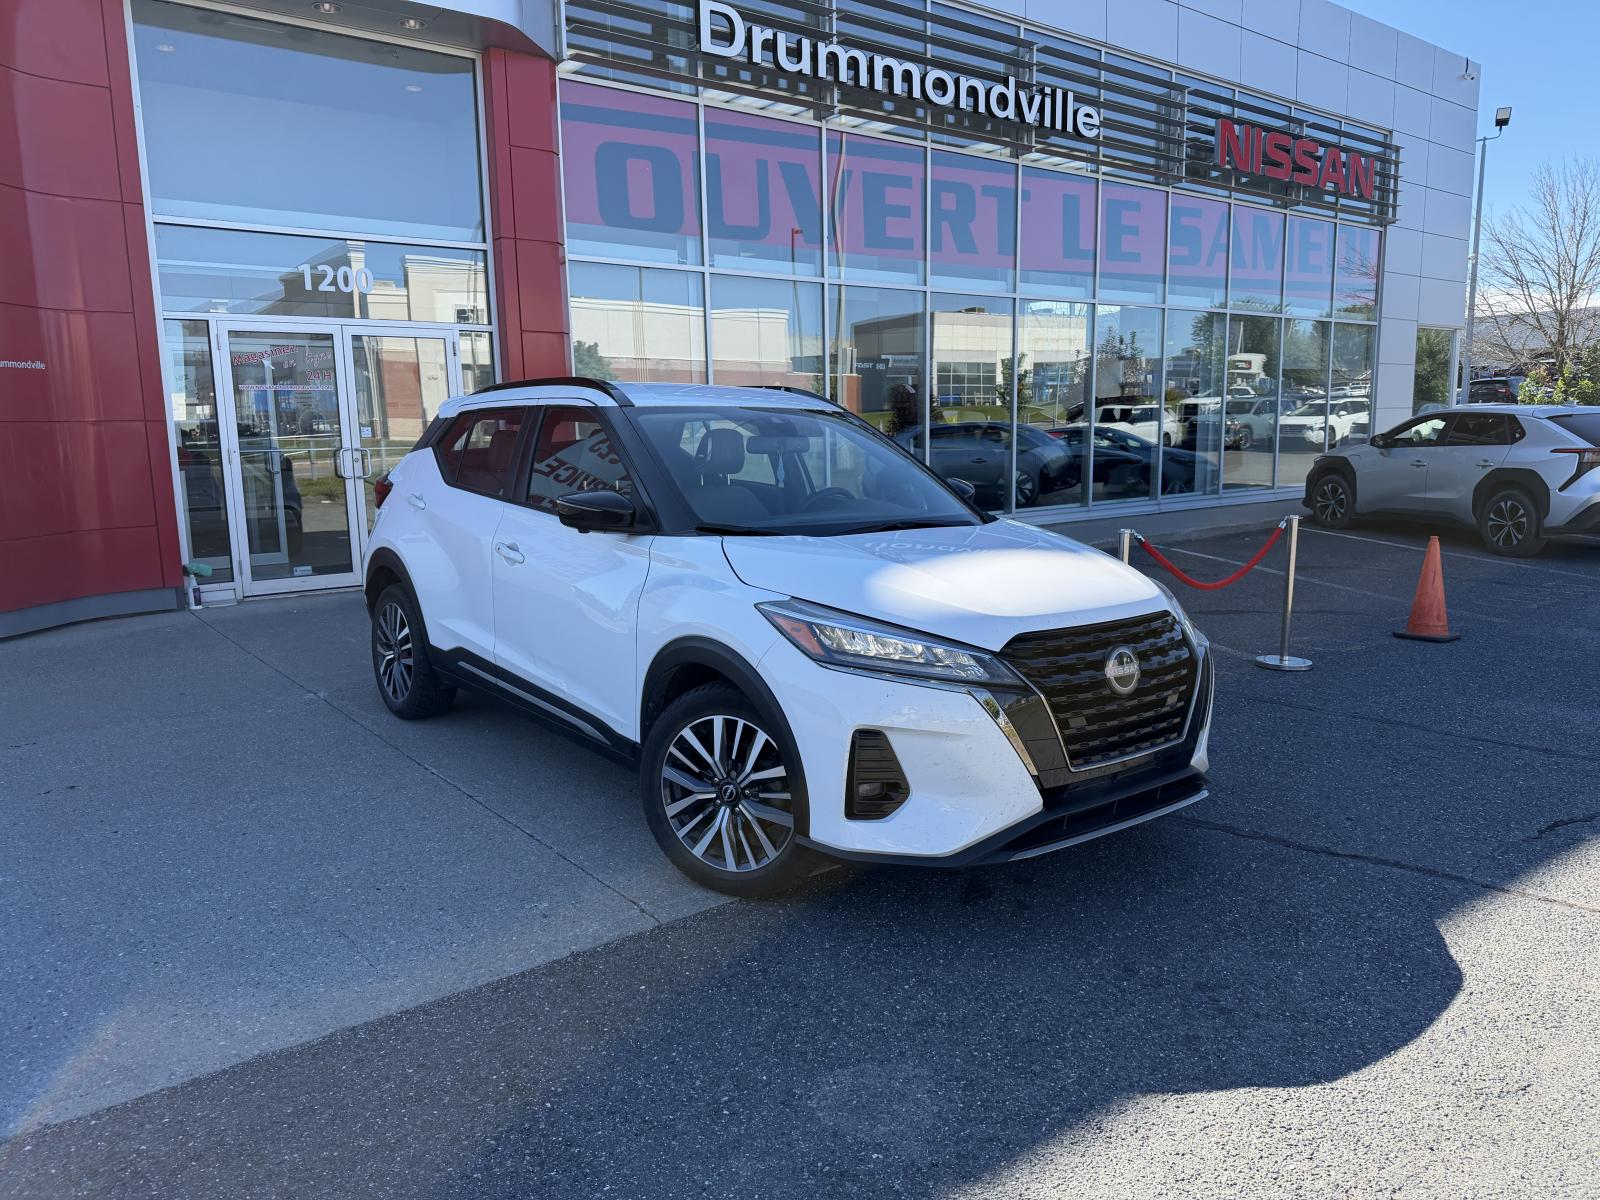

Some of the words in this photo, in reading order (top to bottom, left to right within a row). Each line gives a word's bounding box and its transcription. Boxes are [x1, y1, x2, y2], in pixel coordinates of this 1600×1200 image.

[699, 0, 1101, 138] Drummondville
[594, 141, 1031, 257] OUVERT
[1062, 194, 1142, 263] LE
[1168, 206, 1371, 275] SAMEDI
[1215, 118, 1375, 199] NISSAN
[297, 263, 374, 294] 1200
